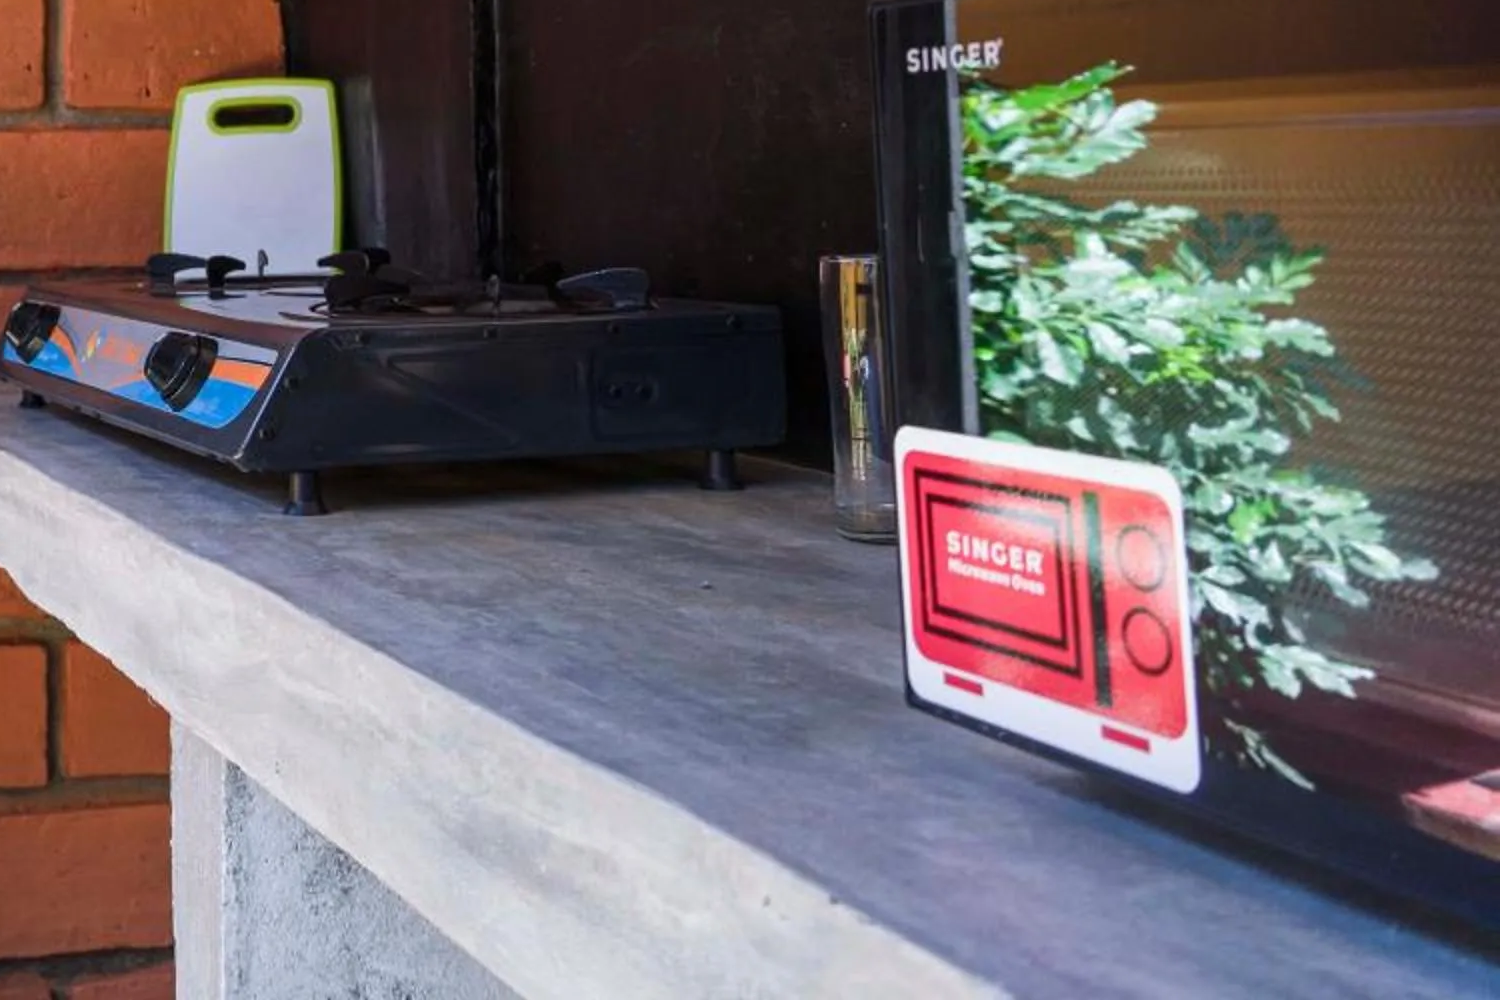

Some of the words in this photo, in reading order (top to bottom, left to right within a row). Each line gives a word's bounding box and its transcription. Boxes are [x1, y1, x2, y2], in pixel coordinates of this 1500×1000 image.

[906, 40, 1001, 73] SINGER
[946, 530, 1044, 576] SINGER
[947, 557, 1010, 588] Micro
